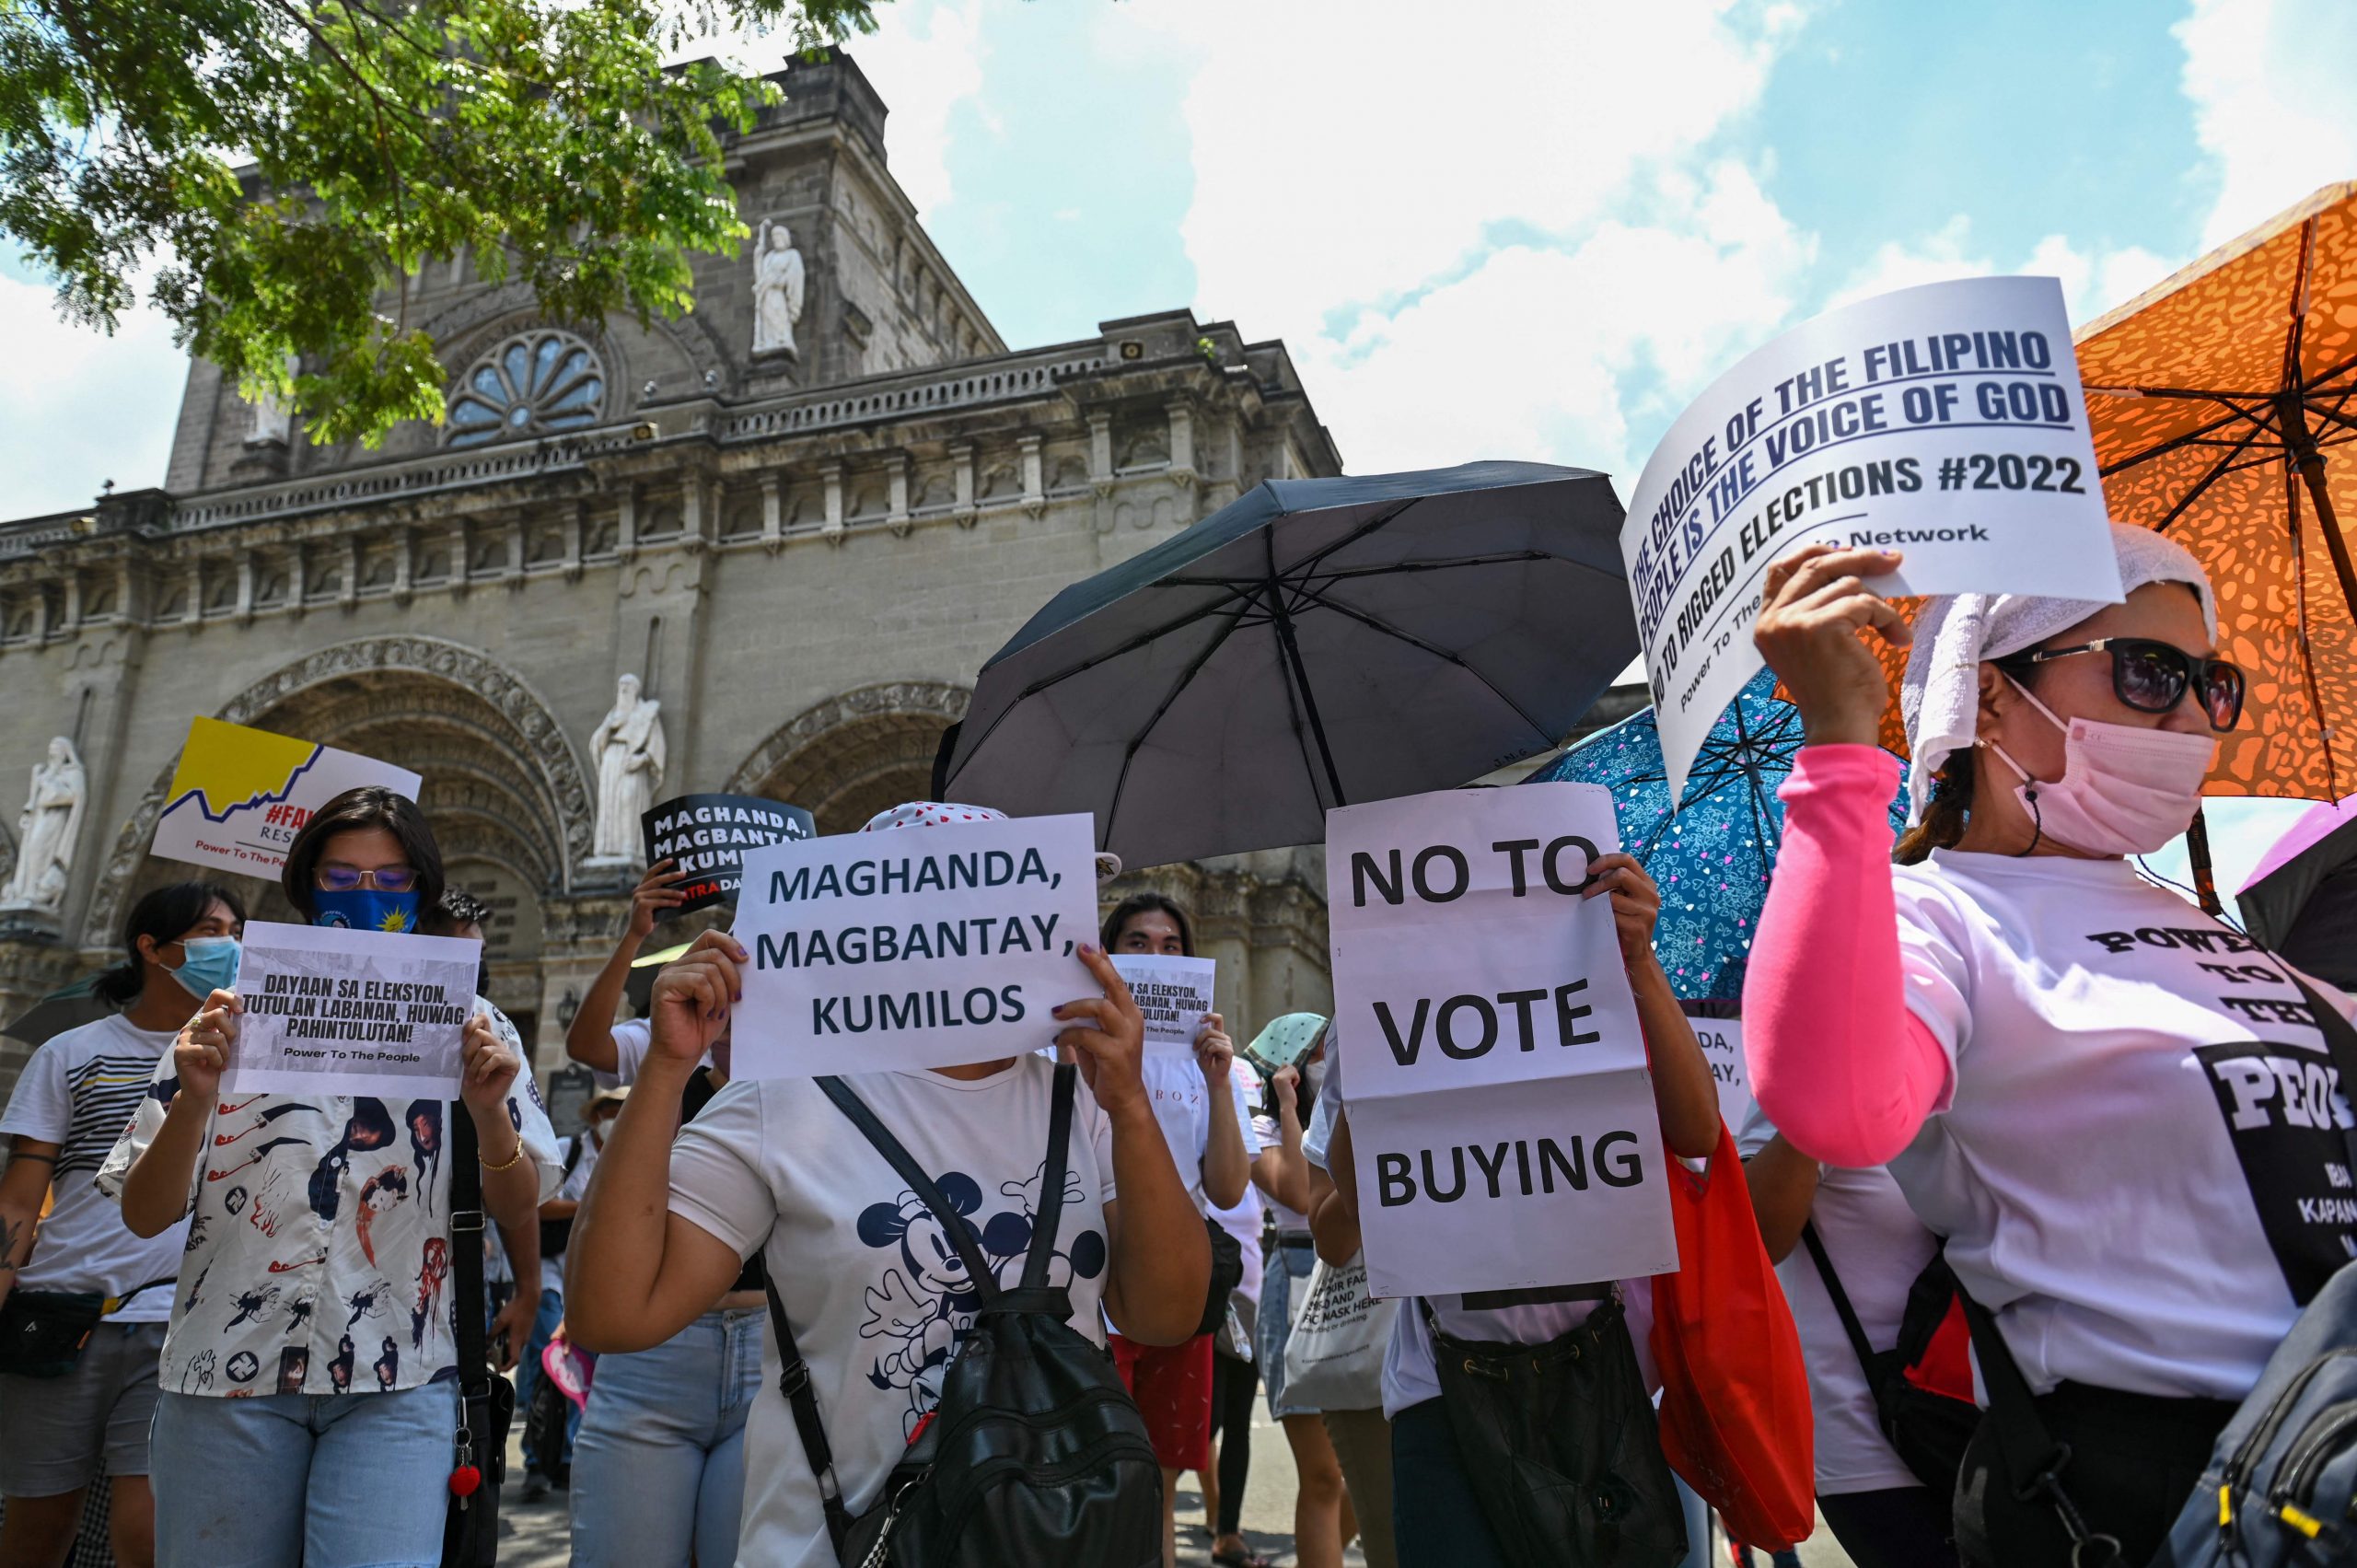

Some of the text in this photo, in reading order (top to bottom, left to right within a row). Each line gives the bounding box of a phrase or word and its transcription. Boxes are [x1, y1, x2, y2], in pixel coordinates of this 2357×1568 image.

[1633, 536, 1654, 604] THE
[1651, 436, 1717, 553] CHOICE
[1725, 397, 1763, 453] OF
[1775, 357, 1850, 416] THE
[1864, 331, 2051, 382] FILIPINO
[1640, 381, 2071, 657] PEOPLE IS THE VOICE OF GOD
[1662, 633, 1678, 681] TO
[1677, 545, 1736, 650] RIGGED
[1740, 457, 1923, 564] ELECTIONS
[1938, 453, 2087, 495] #2022
[1680, 524, 1990, 714] Power To The Network
[654, 807, 807, 838] MAGHANDA,
[195, 840, 230, 855] Power
[234, 848, 247, 859] To
[250, 852, 270, 864] The
[654, 829, 801, 859] MAGBANTA
[768, 847, 1062, 905] MAGHANDA,
[1351, 836, 1602, 908] NO TO
[756, 913, 1074, 970] MAGBANTAY,
[2195, 962, 2285, 983] TO
[264, 974, 448, 1005] DAYAAN SA ELEKSYON,
[1137, 983, 1148, 994] SA
[1152, 984, 1198, 999] ELEKSYON,
[1176, 999, 1208, 1012] HUWAG
[242, 993, 465, 1025] TUTULAN LABANAN, HUWAG
[812, 984, 1026, 1036] KUMILOS
[1372, 978, 1600, 1067] VOTE
[285, 1017, 413, 1043] PAHINTULUTAN!
[284, 1047, 420, 1063] Power To The People
[1376, 1130, 1643, 1208] BUYING
[1331, 1291, 1354, 1306] AND
